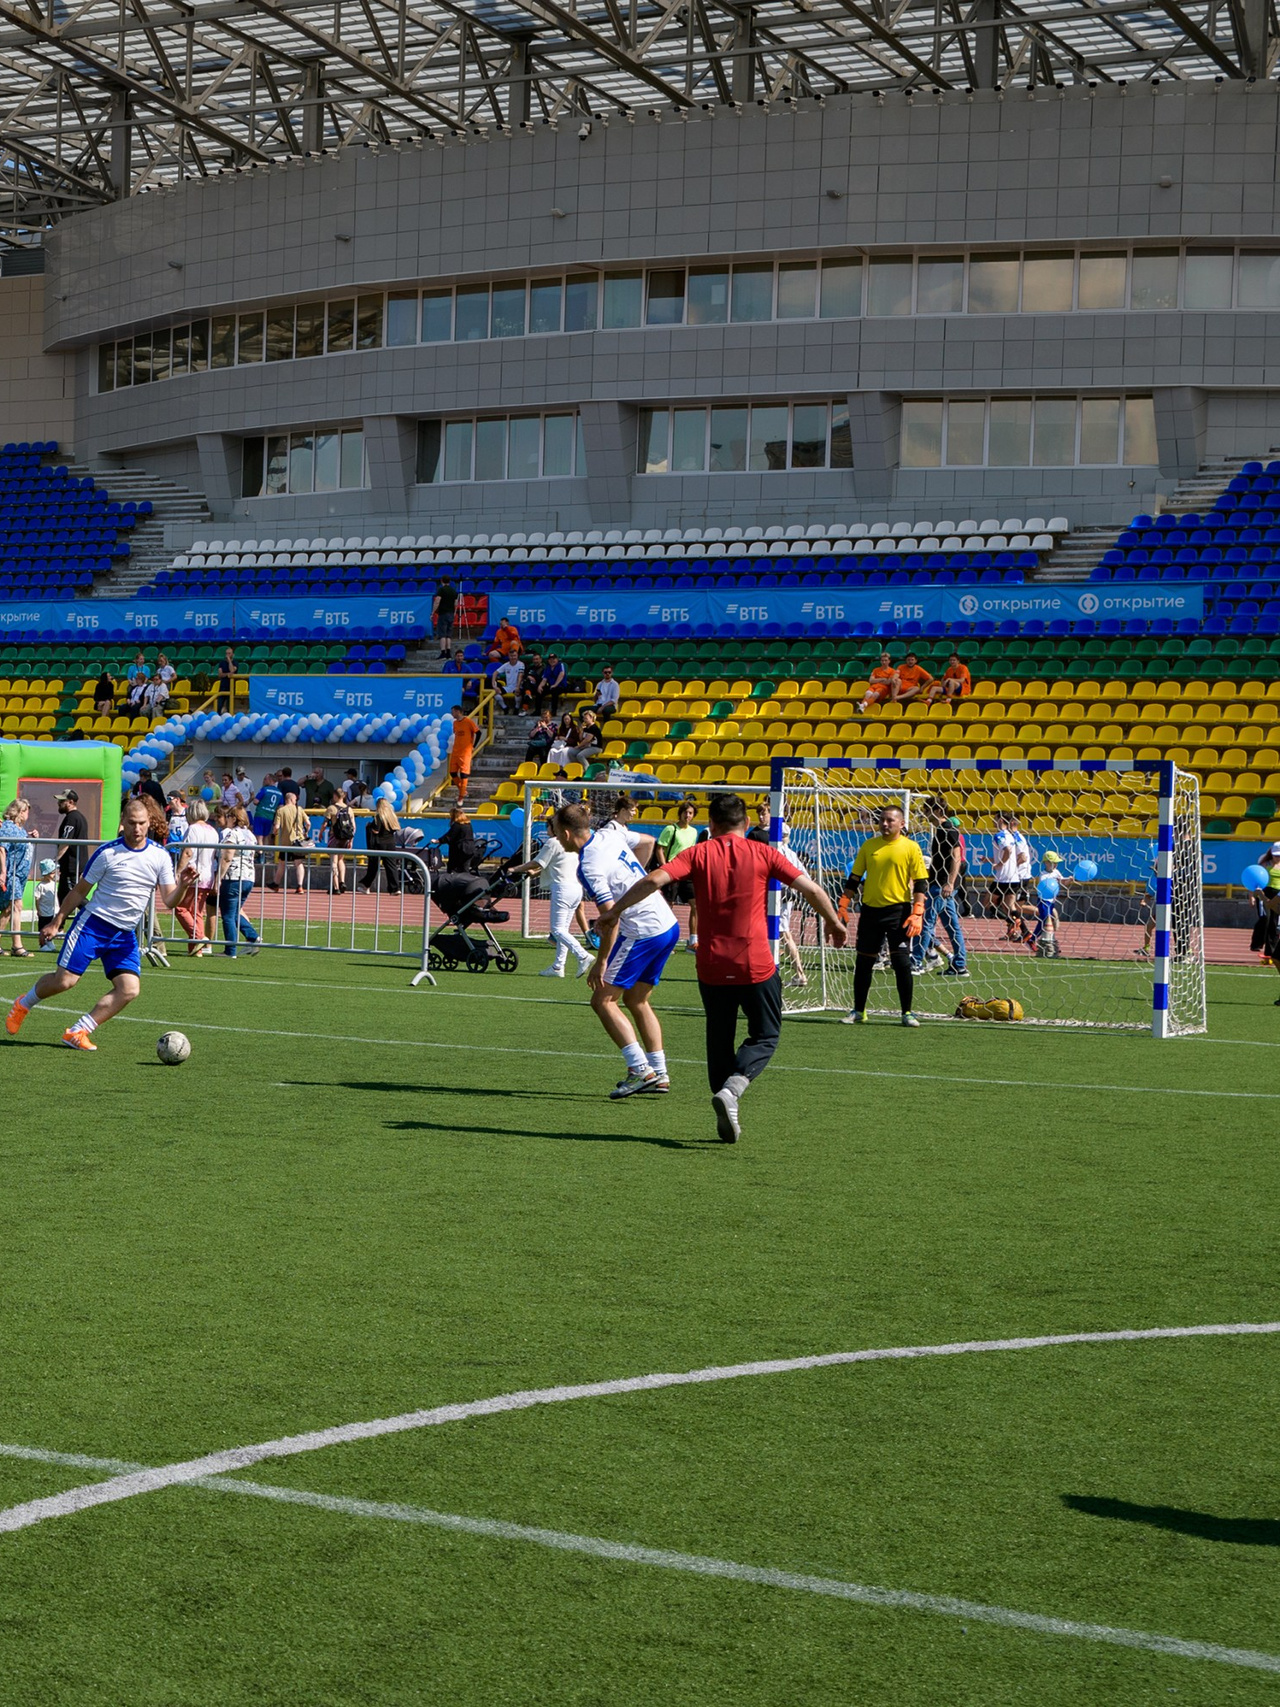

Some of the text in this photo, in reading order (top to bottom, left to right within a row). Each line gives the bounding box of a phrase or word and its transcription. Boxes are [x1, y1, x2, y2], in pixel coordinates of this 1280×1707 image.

[983, 596, 1185, 613] открытие открытие
[76, 613, 218, 628] ВТБ ВТБ ВТБ
[261, 610, 415, 626] ВТБ ВТБ ВТБ
[520, 608, 689, 623] ВТБ ВТБ ВТБ
[739, 605, 924, 621] ВТБ ВТБ ВТБ
[278, 692, 443, 707] ВТБ ВТБ ВТБ
[269, 794, 277, 808] 9
